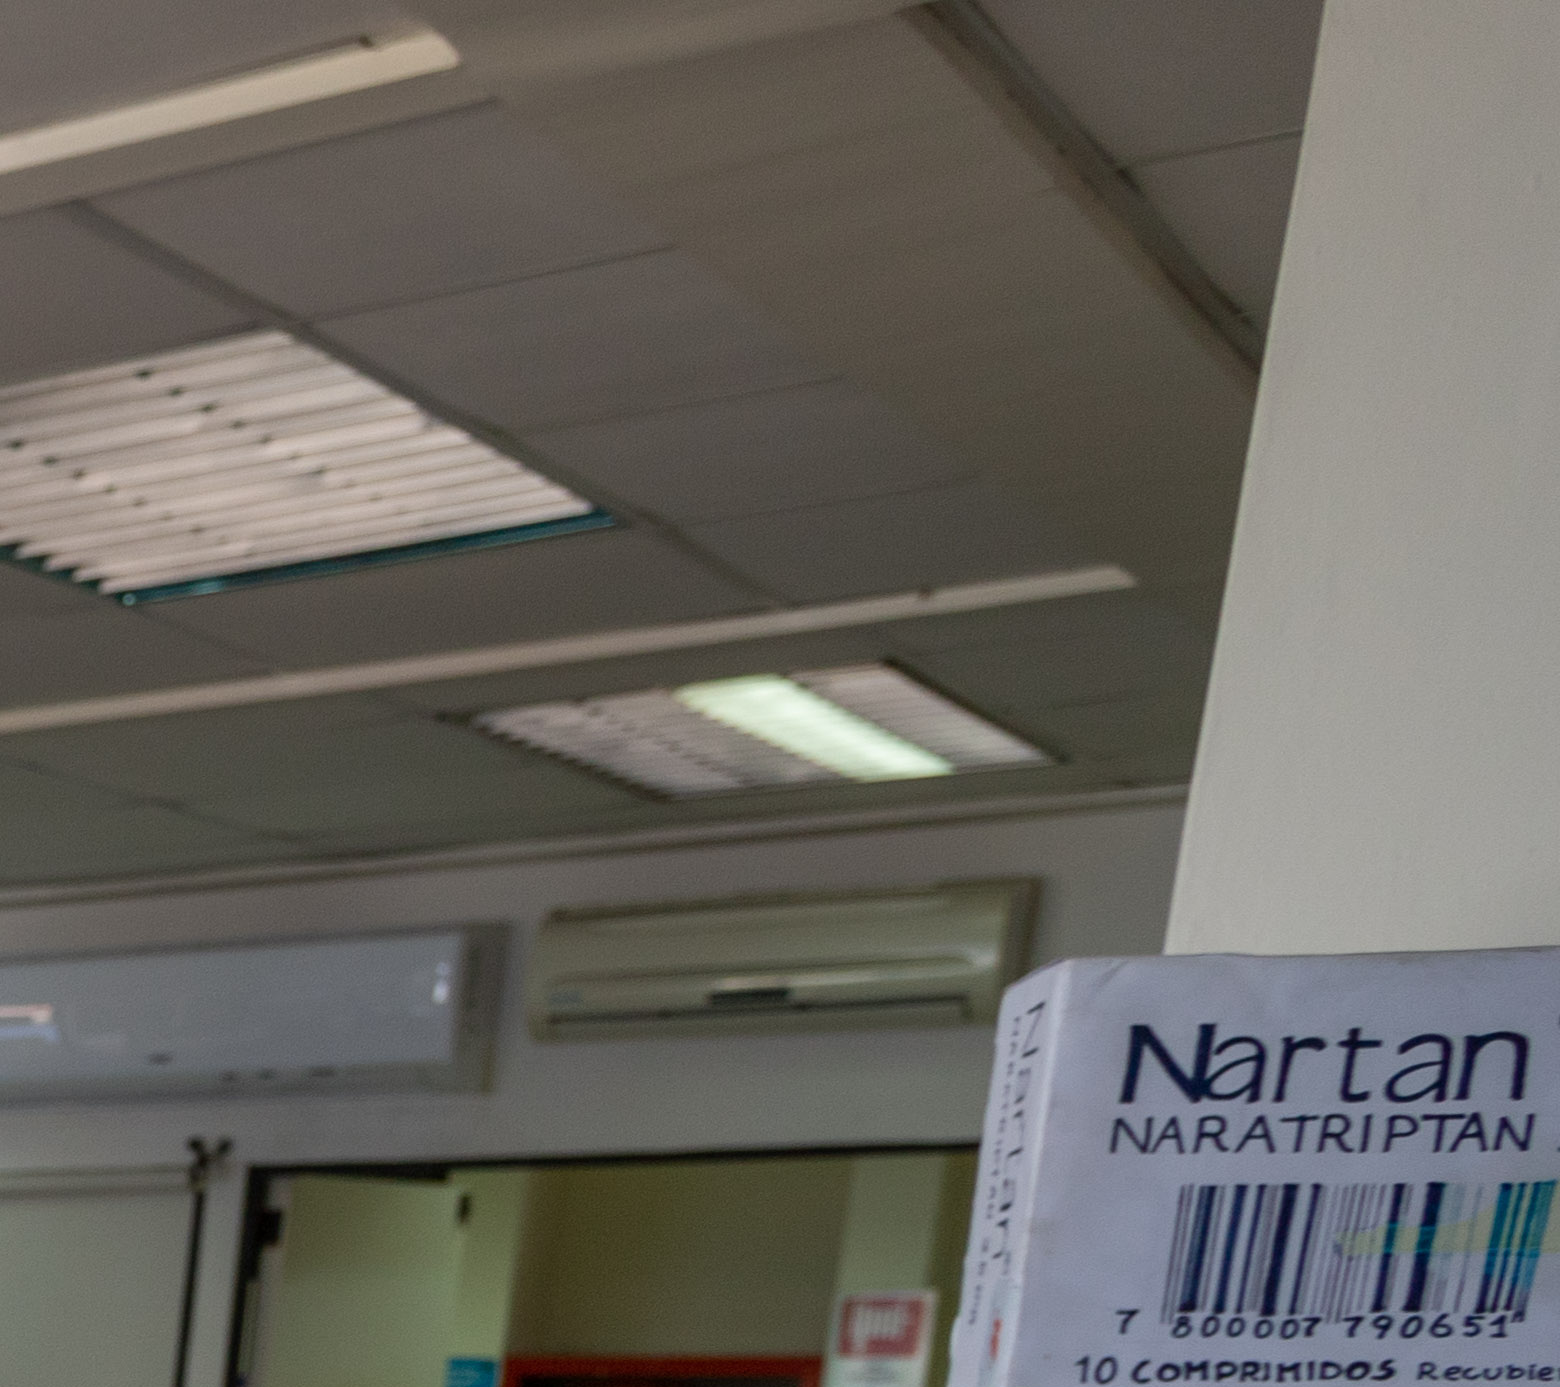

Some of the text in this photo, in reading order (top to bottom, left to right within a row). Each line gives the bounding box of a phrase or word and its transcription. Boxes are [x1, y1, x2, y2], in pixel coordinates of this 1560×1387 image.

[1119, 1022, 1530, 1104] Nartan
[1109, 1114, 1536, 1154] NARATRIPTAN
[1116, 1308, 1510, 1341] 7 800007 790651
[1074, 1356, 1118, 1385] 10
[1131, 1358, 1397, 1385] COMPRIMIDOS
